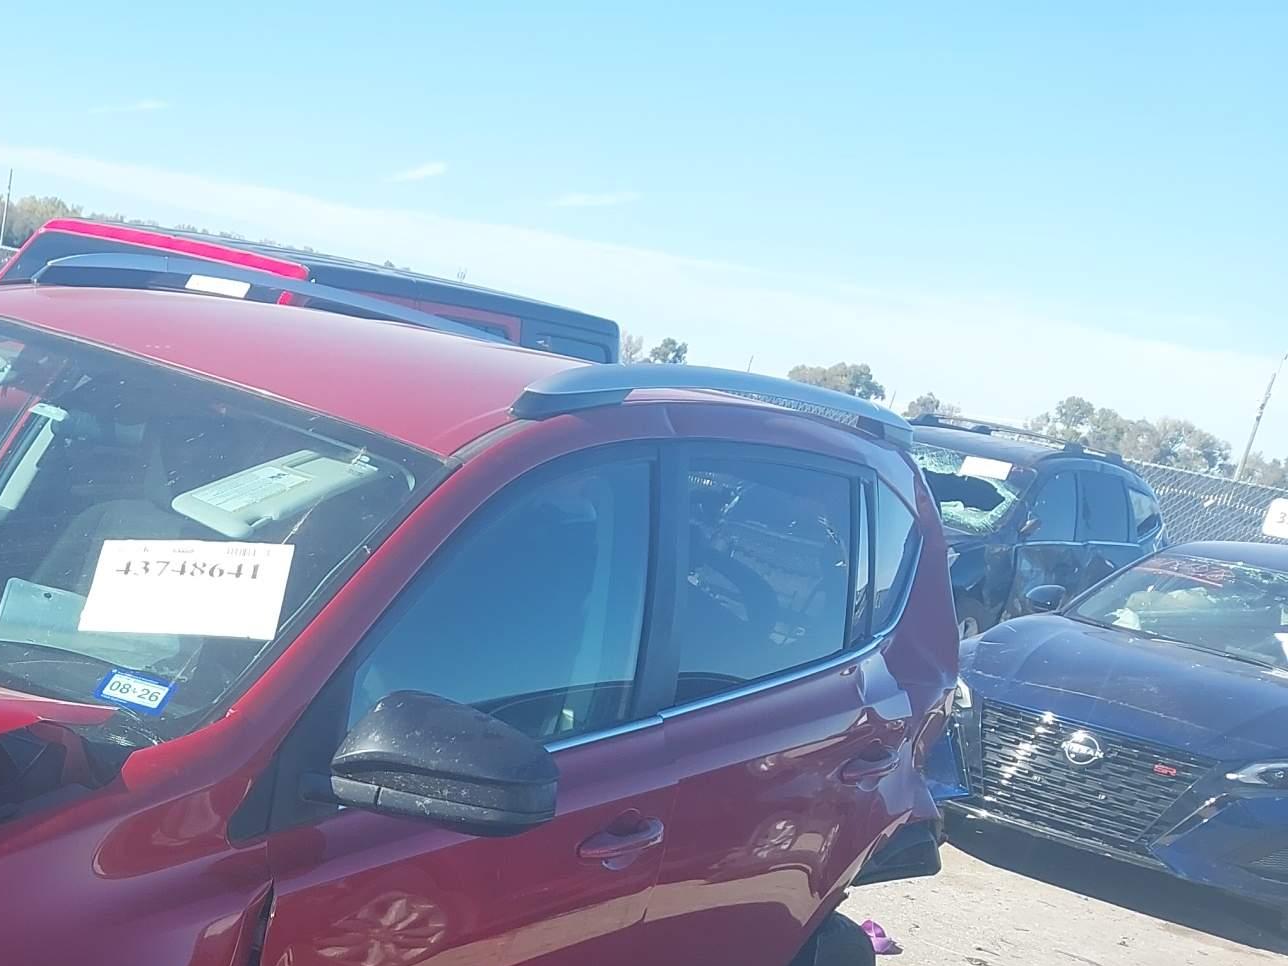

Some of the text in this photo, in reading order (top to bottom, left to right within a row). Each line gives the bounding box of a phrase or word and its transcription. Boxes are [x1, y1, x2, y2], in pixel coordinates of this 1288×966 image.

[1274, 510, 1288, 526] 3
[115, 560, 260, 580] 43748641
[109, 680, 132, 694] 08
[137, 687, 161, 702] 26
